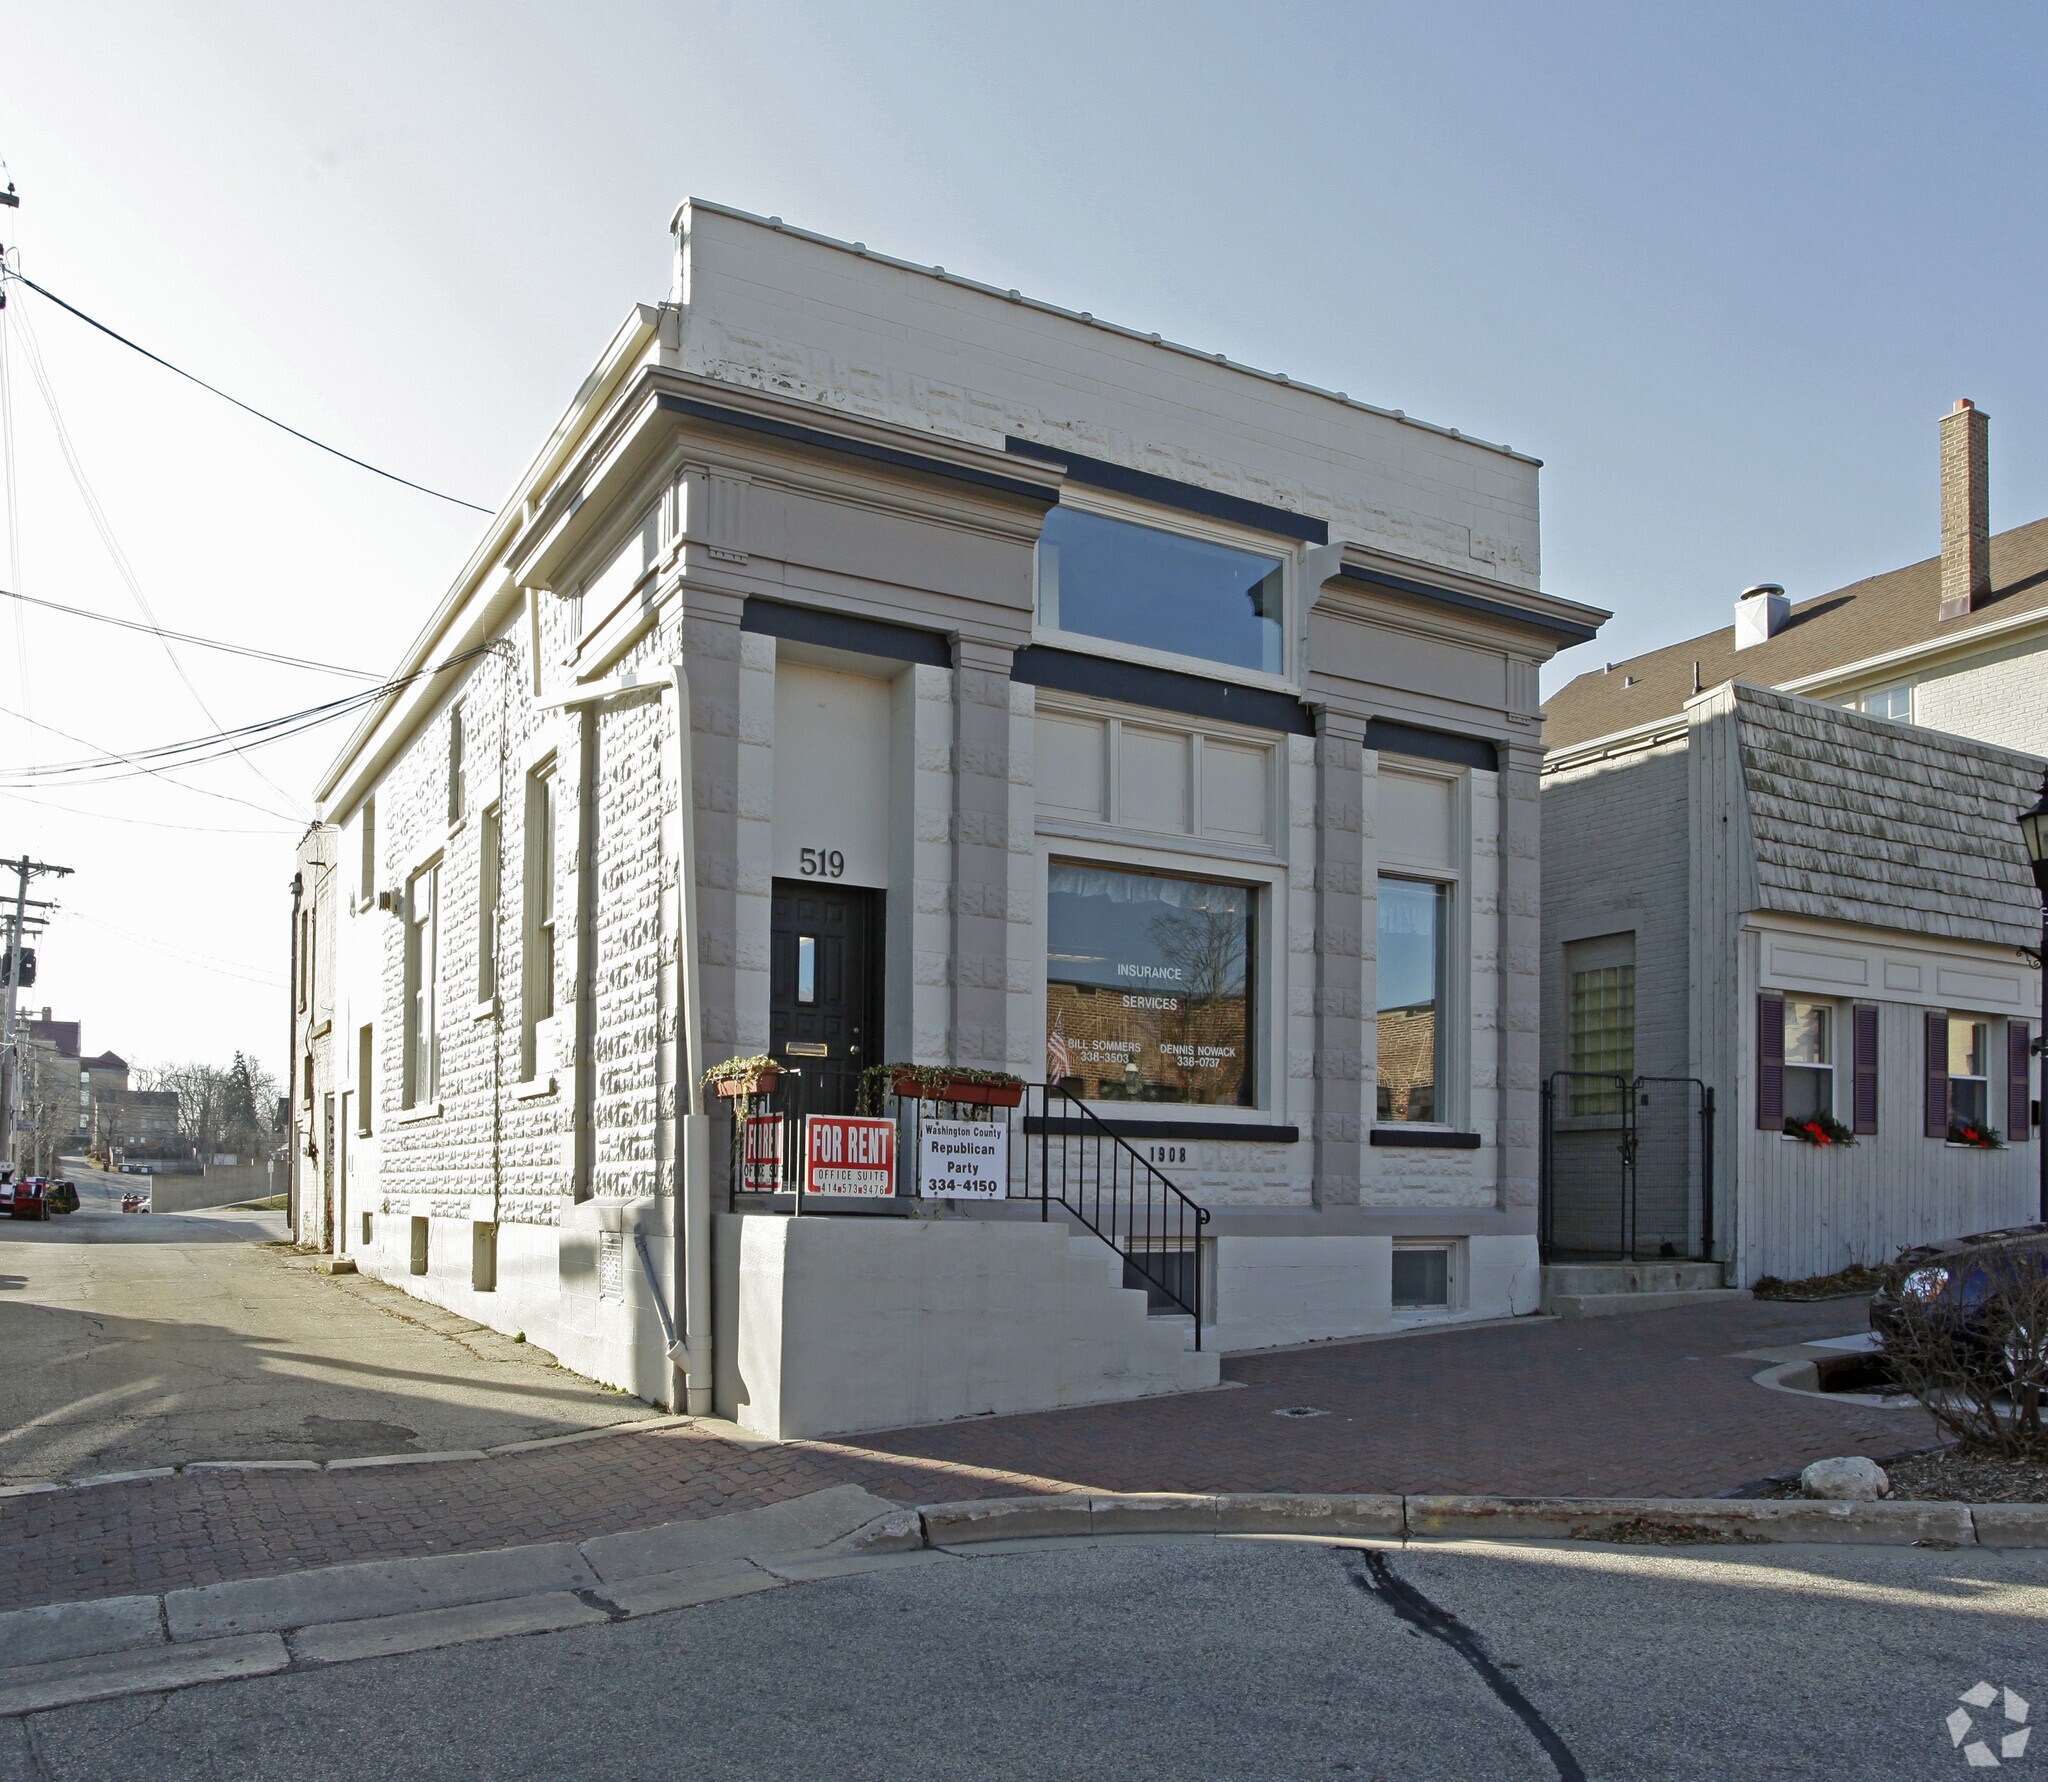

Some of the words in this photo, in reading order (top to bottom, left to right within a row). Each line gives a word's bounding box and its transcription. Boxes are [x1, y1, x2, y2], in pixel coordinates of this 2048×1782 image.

[800, 847, 845, 878] 519
[1117, 963, 1182, 981] INSURANCE
[1122, 995, 1178, 1011] SERVICES
[1067, 1038, 1088, 1050] BILL
[1092, 1040, 1141, 1053] SOMMERS
[1160, 1043, 1195, 1056] DENNIS
[1197, 1045, 1236, 1057] NOWACK
[1080, 1051, 1130, 1064] 338-3503
[1177, 1056, 1220, 1068] 338-0737
[925, 1124, 971, 1138] Washington
[974, 1127, 1002, 1140] County
[812, 1124, 843, 1163] FOR
[848, 1126, 890, 1165] RENT
[931, 1140, 995, 1155] Republican
[1150, 1146, 1186, 1163] 1908
[818, 1169, 852, 1181] OFFICE
[857, 1170, 885, 1181] SUITE
[947, 1161, 979, 1176] Party
[928, 1178, 997, 1193] 334-4150
